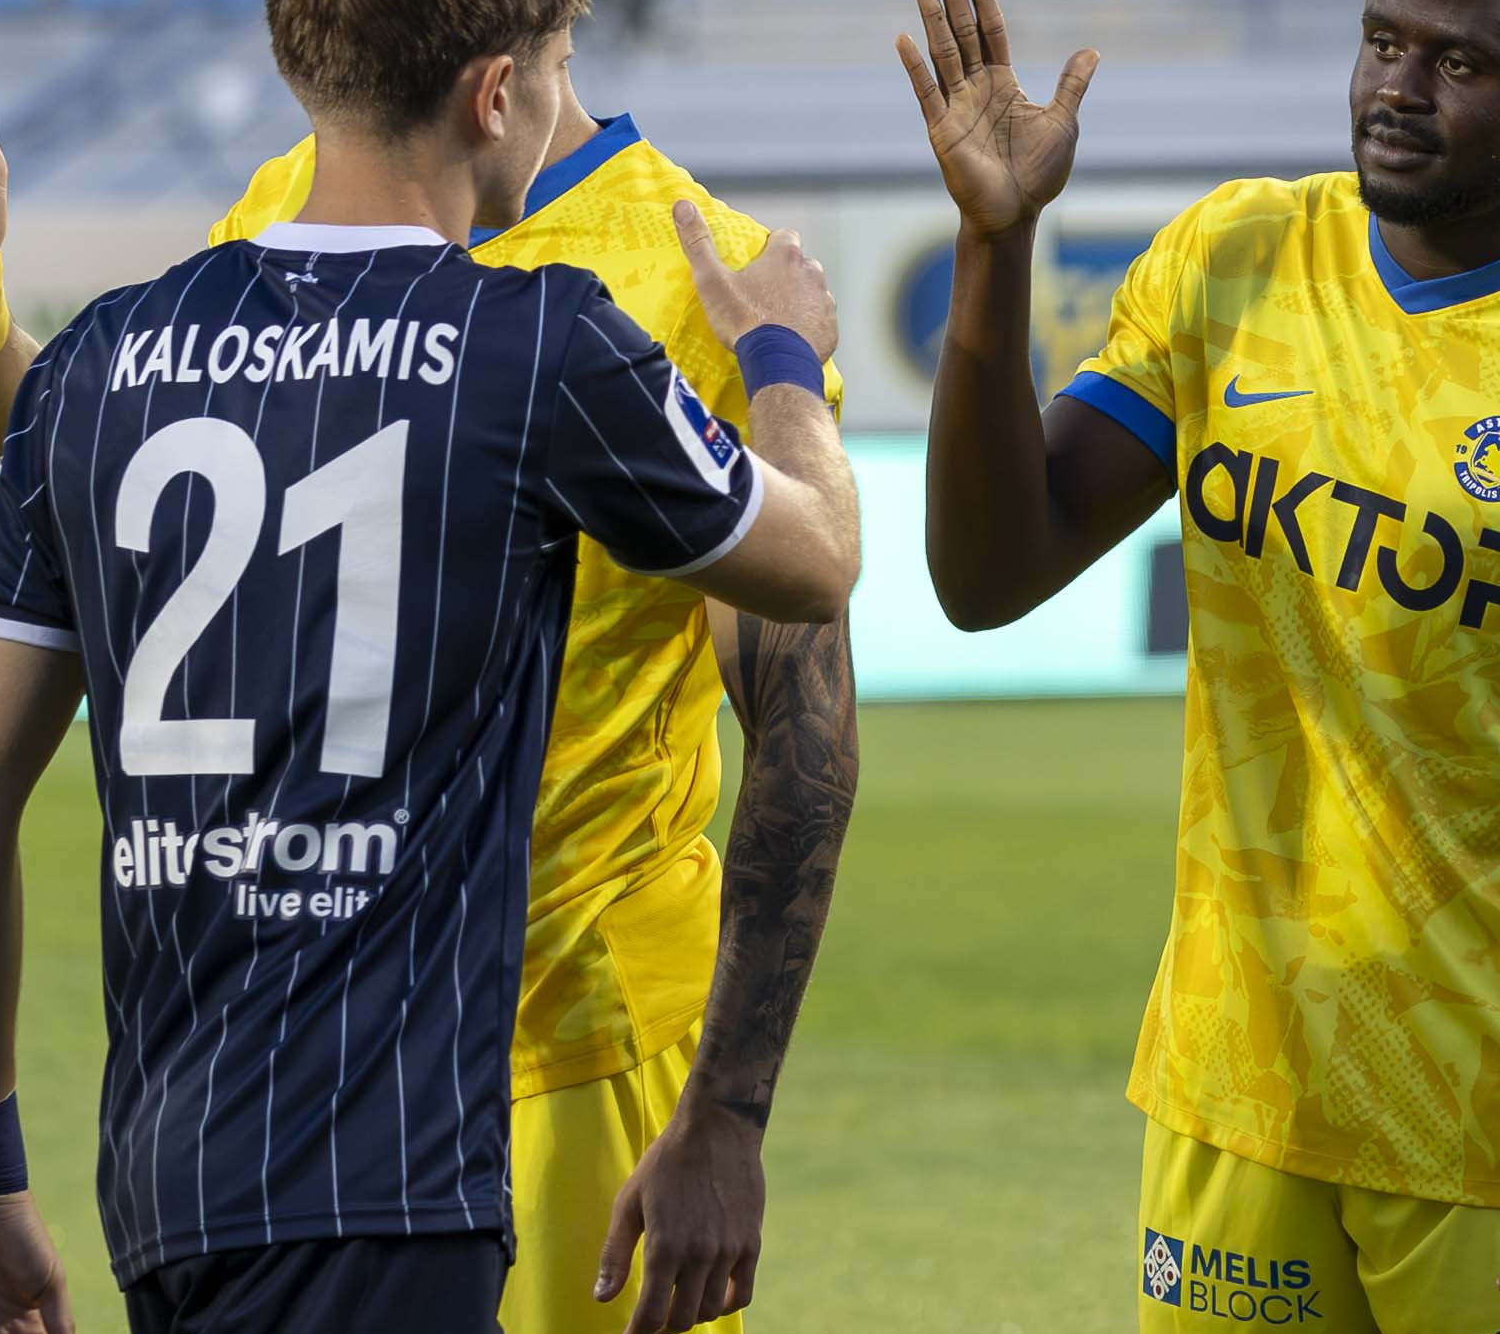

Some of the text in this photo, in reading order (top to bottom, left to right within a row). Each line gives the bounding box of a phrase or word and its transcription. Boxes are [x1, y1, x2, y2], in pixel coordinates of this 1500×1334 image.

[112, 318, 460, 393] KALOSKAMIS
[1460, 470, 1498, 499] TRIPOLIS
[114, 416, 411, 778] 21
[236, 884, 371, 919] live elit
[1191, 1245, 1311, 1290] MELIS
[1190, 1281, 1325, 1325] BLOCK
